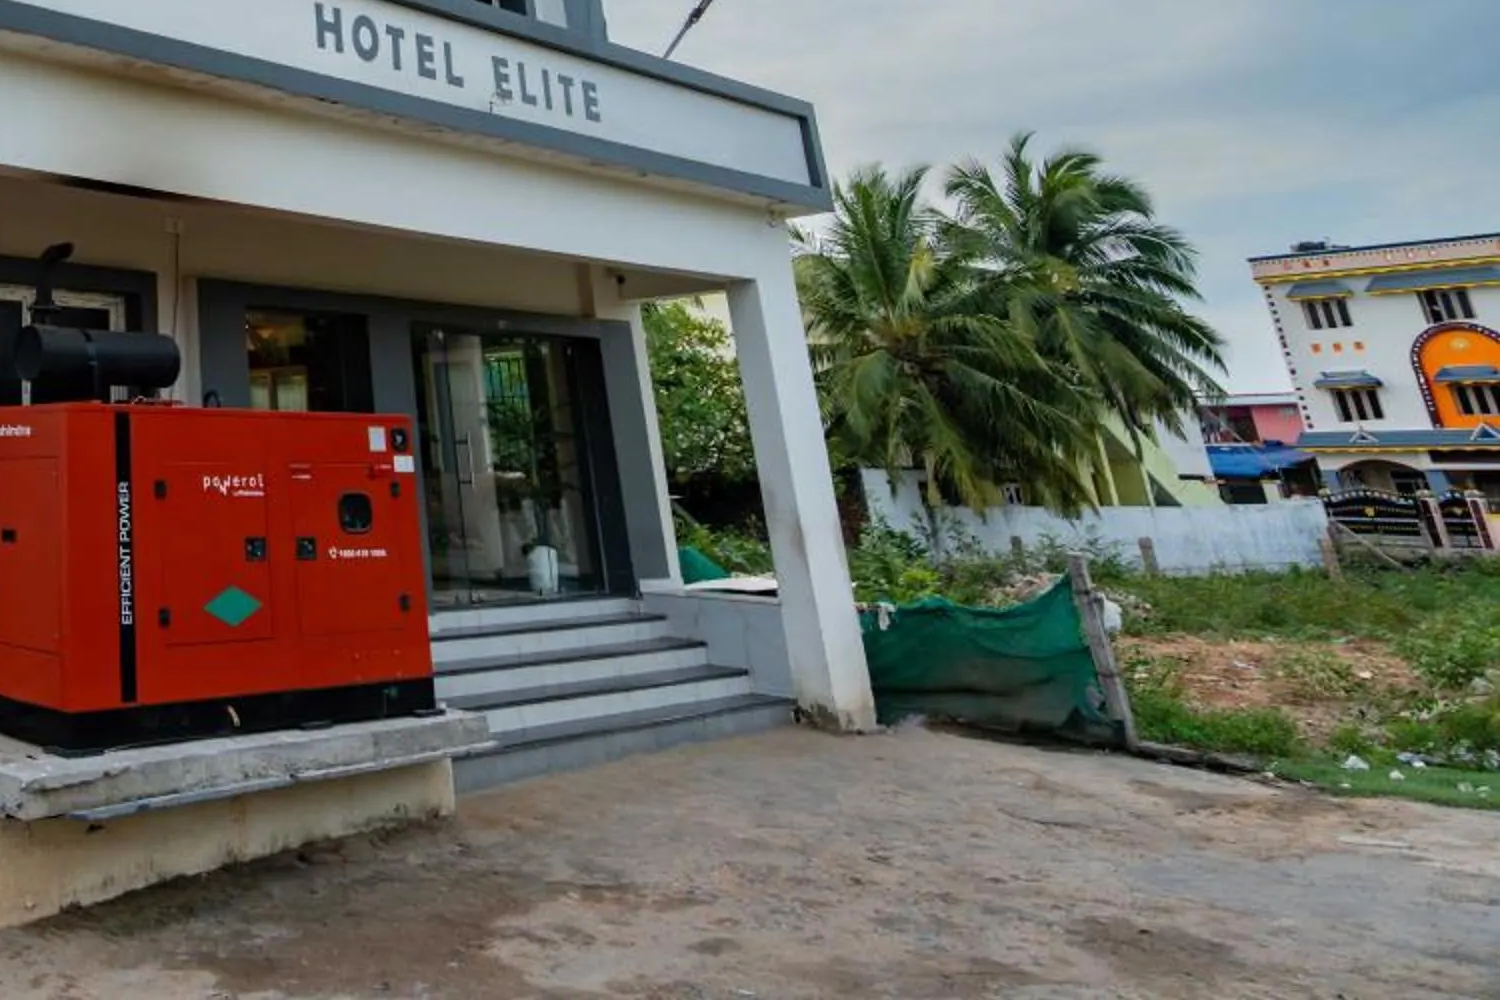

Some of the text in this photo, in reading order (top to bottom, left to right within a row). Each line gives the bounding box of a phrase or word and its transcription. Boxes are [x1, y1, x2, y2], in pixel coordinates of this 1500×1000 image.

[314, 1, 601, 123] HOTEL ELITE
[117, 481, 133, 625] EFFICIENT POWER
